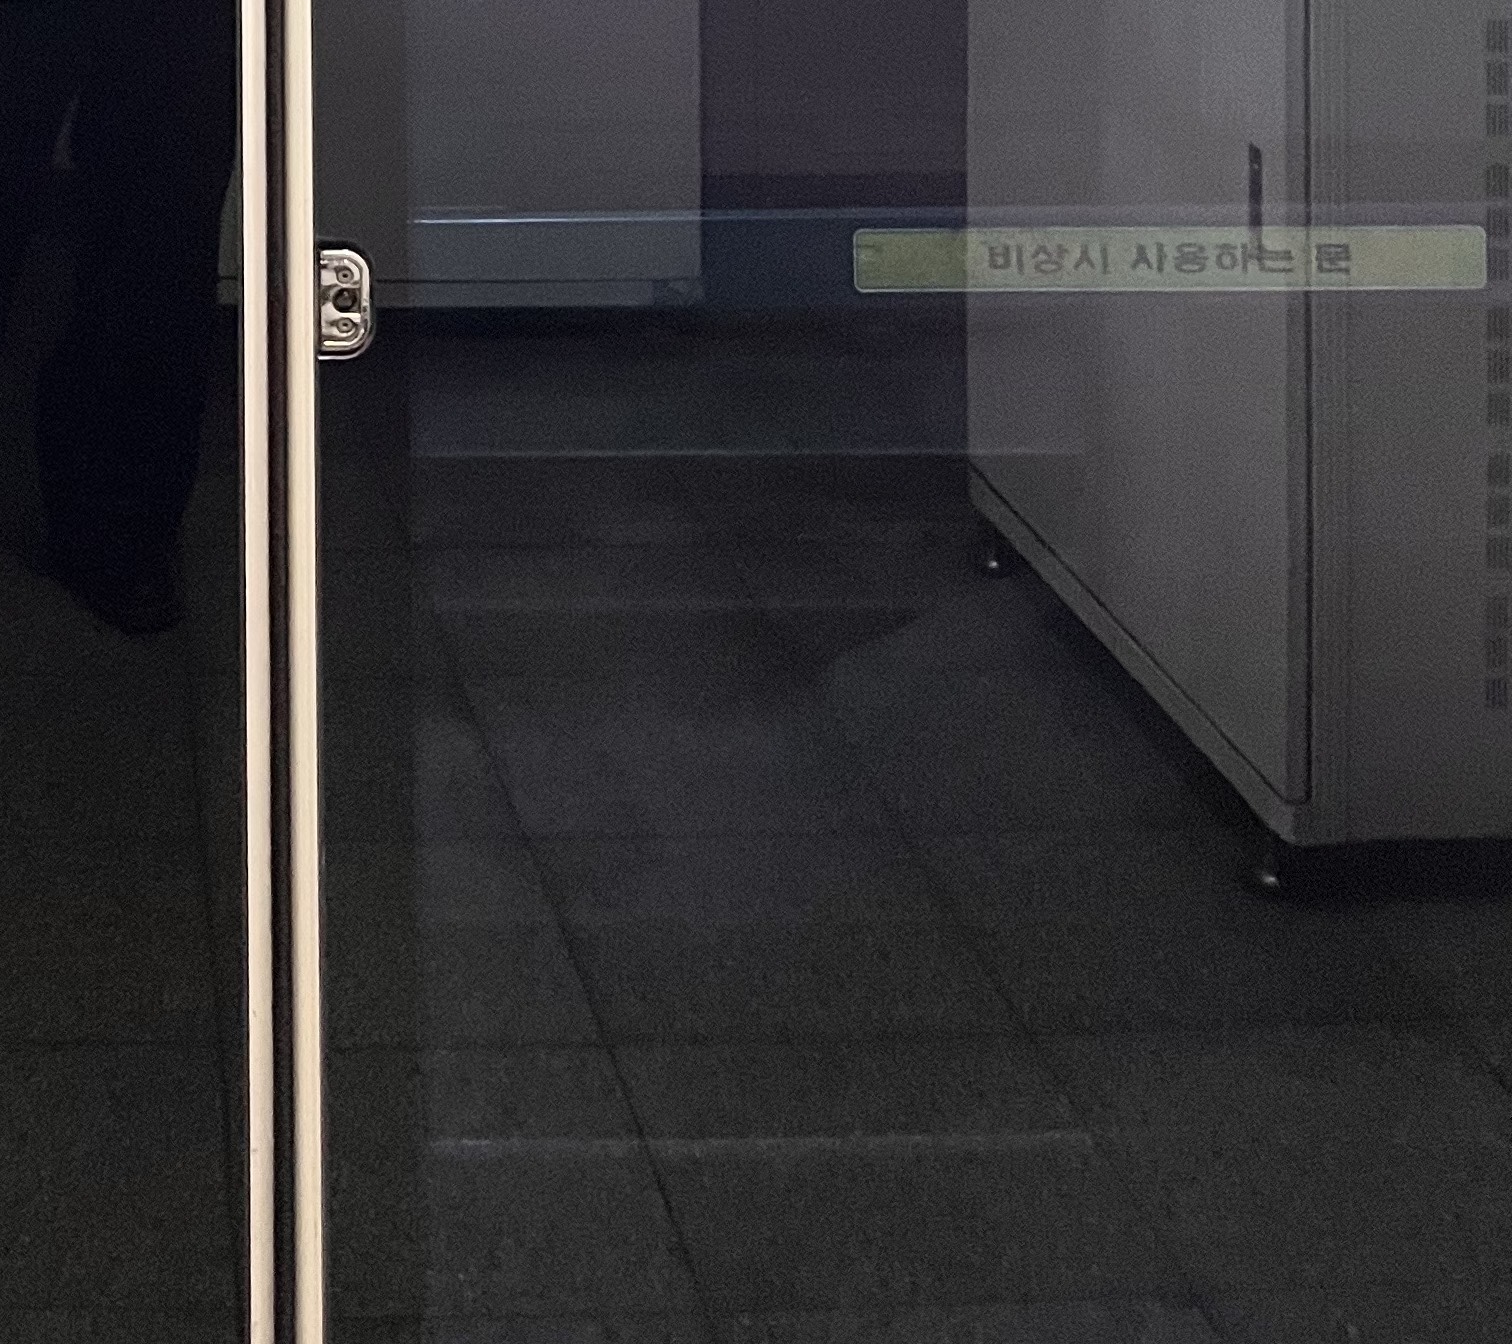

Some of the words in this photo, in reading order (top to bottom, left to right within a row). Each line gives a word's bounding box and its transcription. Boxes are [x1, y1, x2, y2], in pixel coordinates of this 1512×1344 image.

[988, 241, 1111, 276] 비상시
[1131, 241, 1296, 276] 사용하는
[1316, 242, 1353, 275] 문
